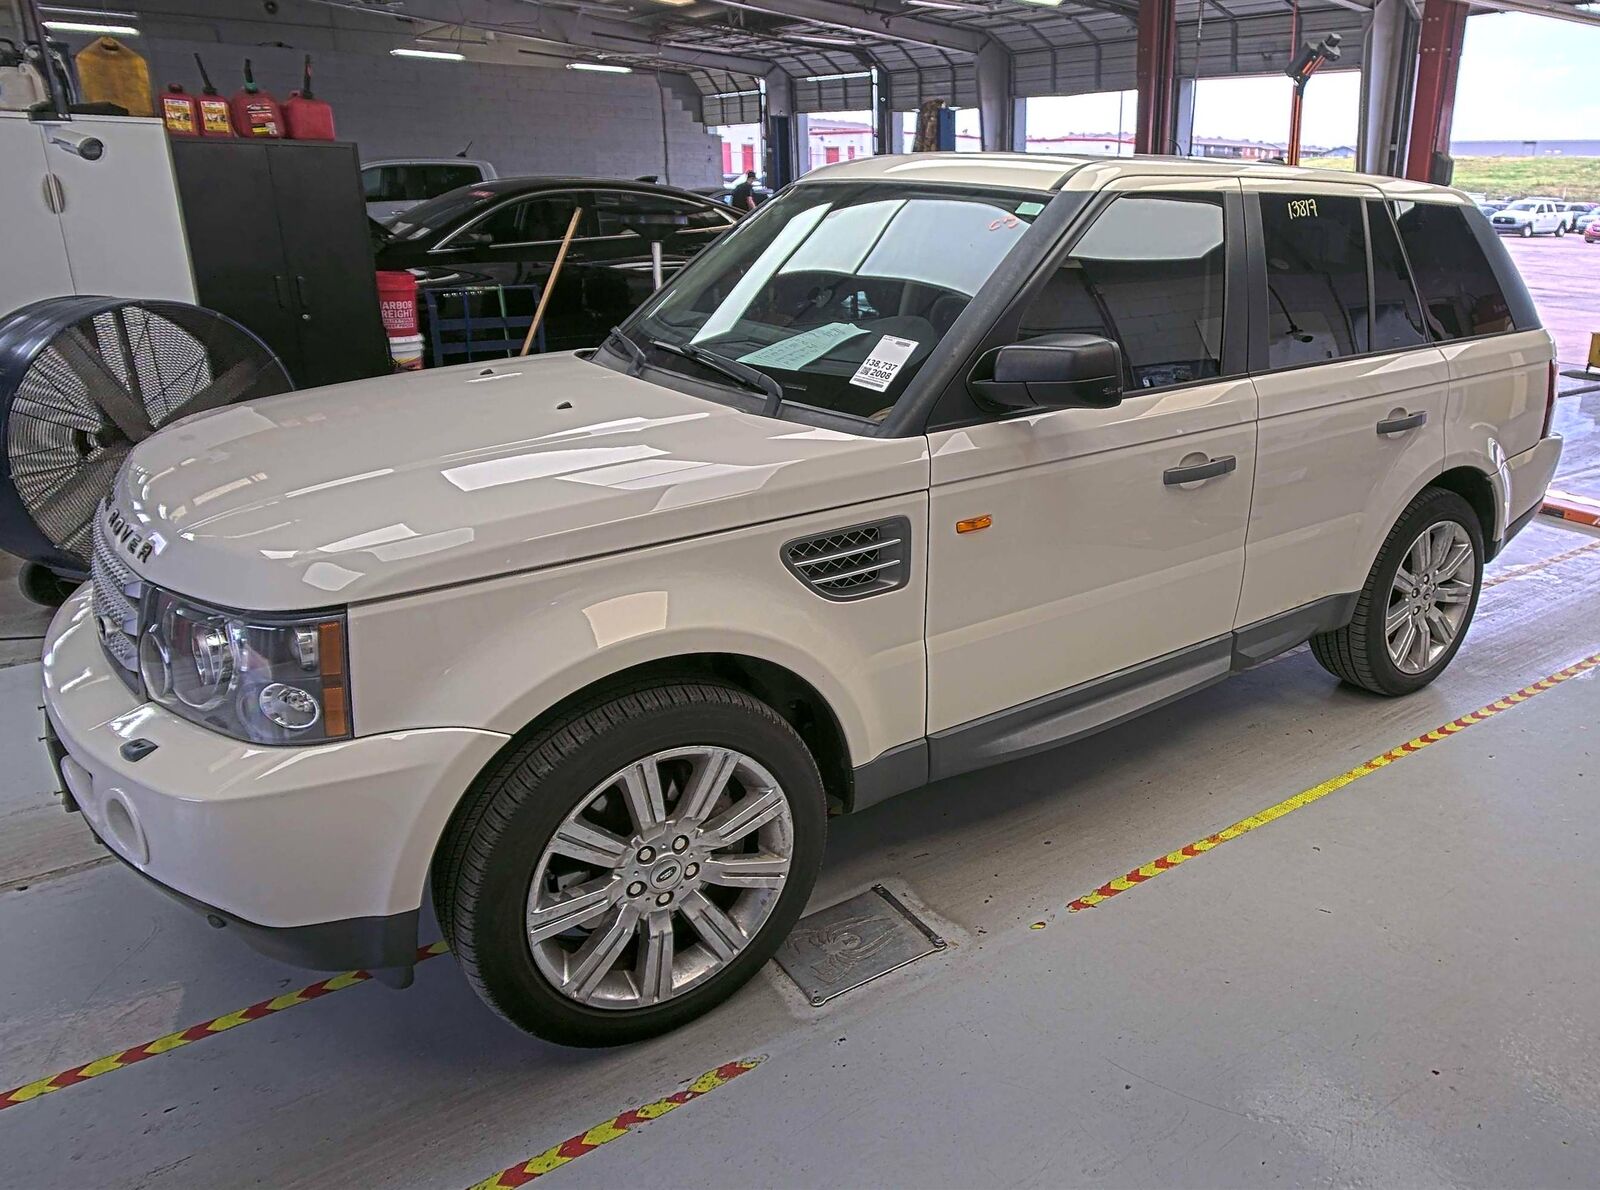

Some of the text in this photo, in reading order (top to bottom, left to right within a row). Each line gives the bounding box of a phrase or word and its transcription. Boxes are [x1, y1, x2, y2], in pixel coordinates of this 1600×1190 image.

[1287, 198, 1319, 220] 13817
[380, 300, 413, 311] ARBOR
[381, 309, 413, 319] REIGHT
[865, 358, 898, 372] 138,737
[869, 368, 893, 380] 2008
[107, 507, 154, 565] ROVER
